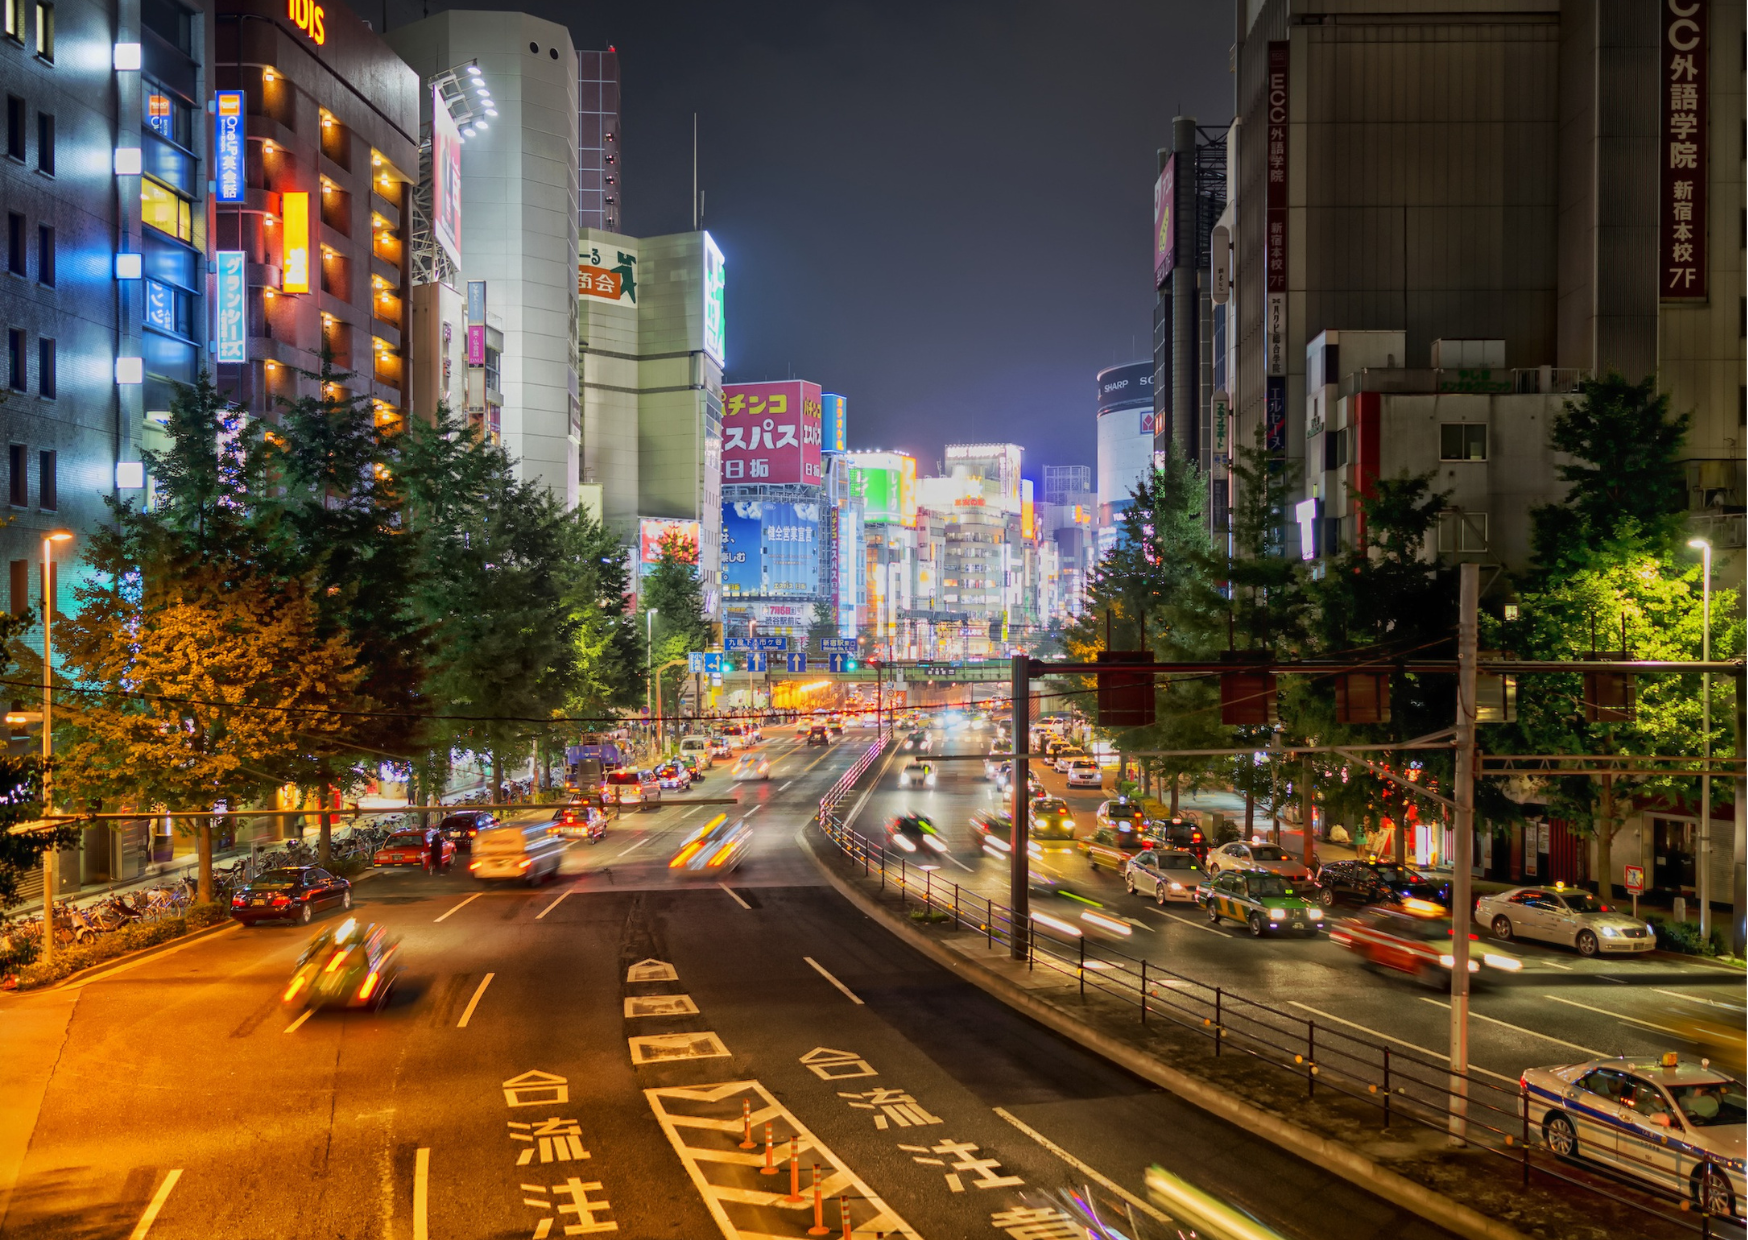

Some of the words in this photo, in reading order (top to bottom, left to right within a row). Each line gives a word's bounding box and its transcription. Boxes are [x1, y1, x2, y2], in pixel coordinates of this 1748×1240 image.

[1673, 180, 1693, 263] 新宿本校
[1270, 222, 1283, 270] 新宿本校
[1270, 275, 1284, 287] 7F
[1668, 268, 1696, 288] 7F
[1104, 379, 1129, 393] SHARP
[1216, 402, 1226, 450] スキンサポート
[1269, 388, 1282, 449] エルセーヌ
[765, 616, 801, 625] 渋谷駅前に
